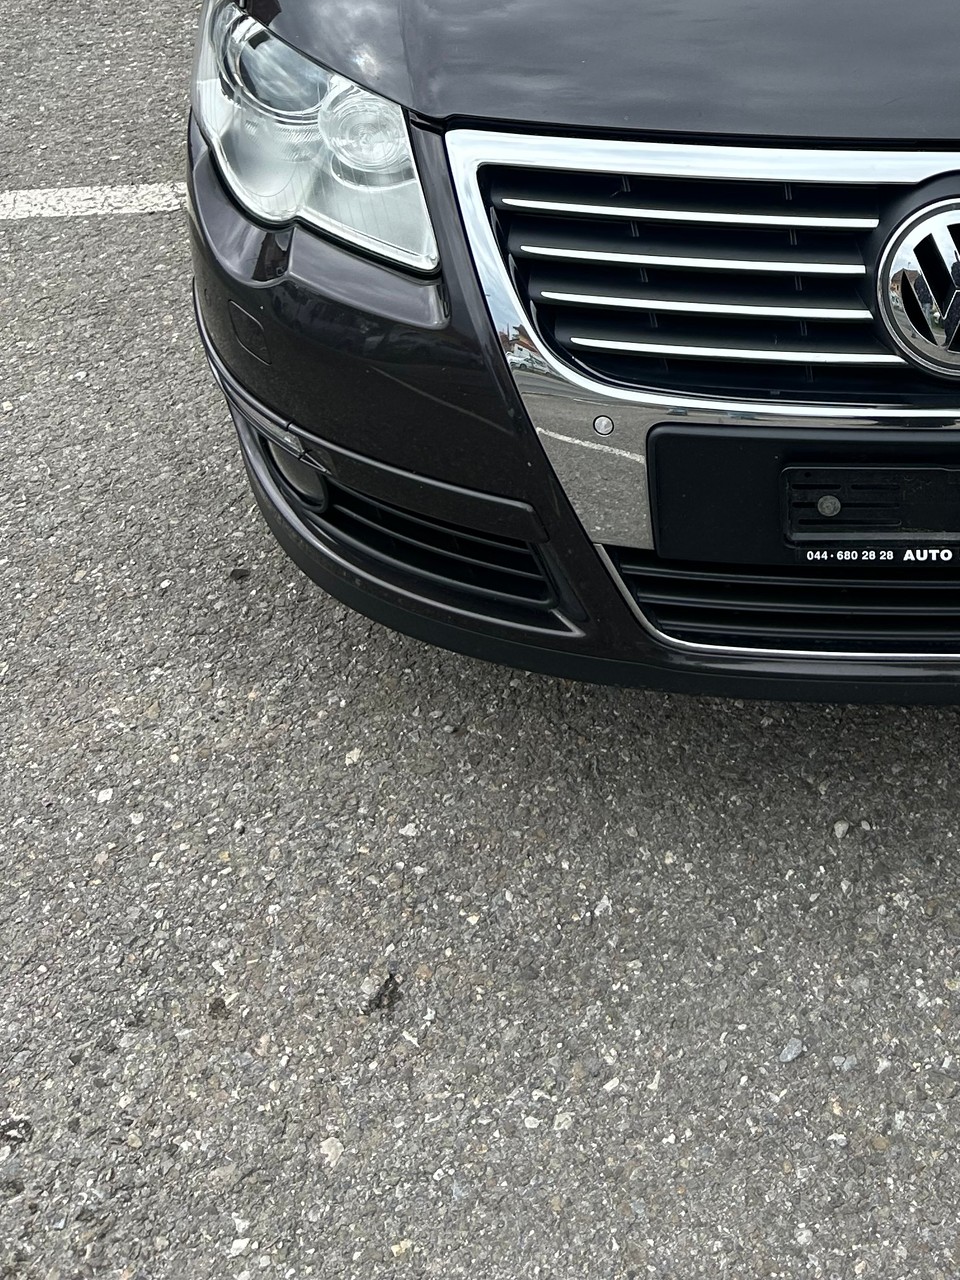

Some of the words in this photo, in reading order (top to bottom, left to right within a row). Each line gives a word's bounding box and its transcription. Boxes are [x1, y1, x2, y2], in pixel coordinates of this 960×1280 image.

[861, 550, 876, 560] 28
[879, 550, 894, 560] 28
[903, 549, 953, 561] AUTO
